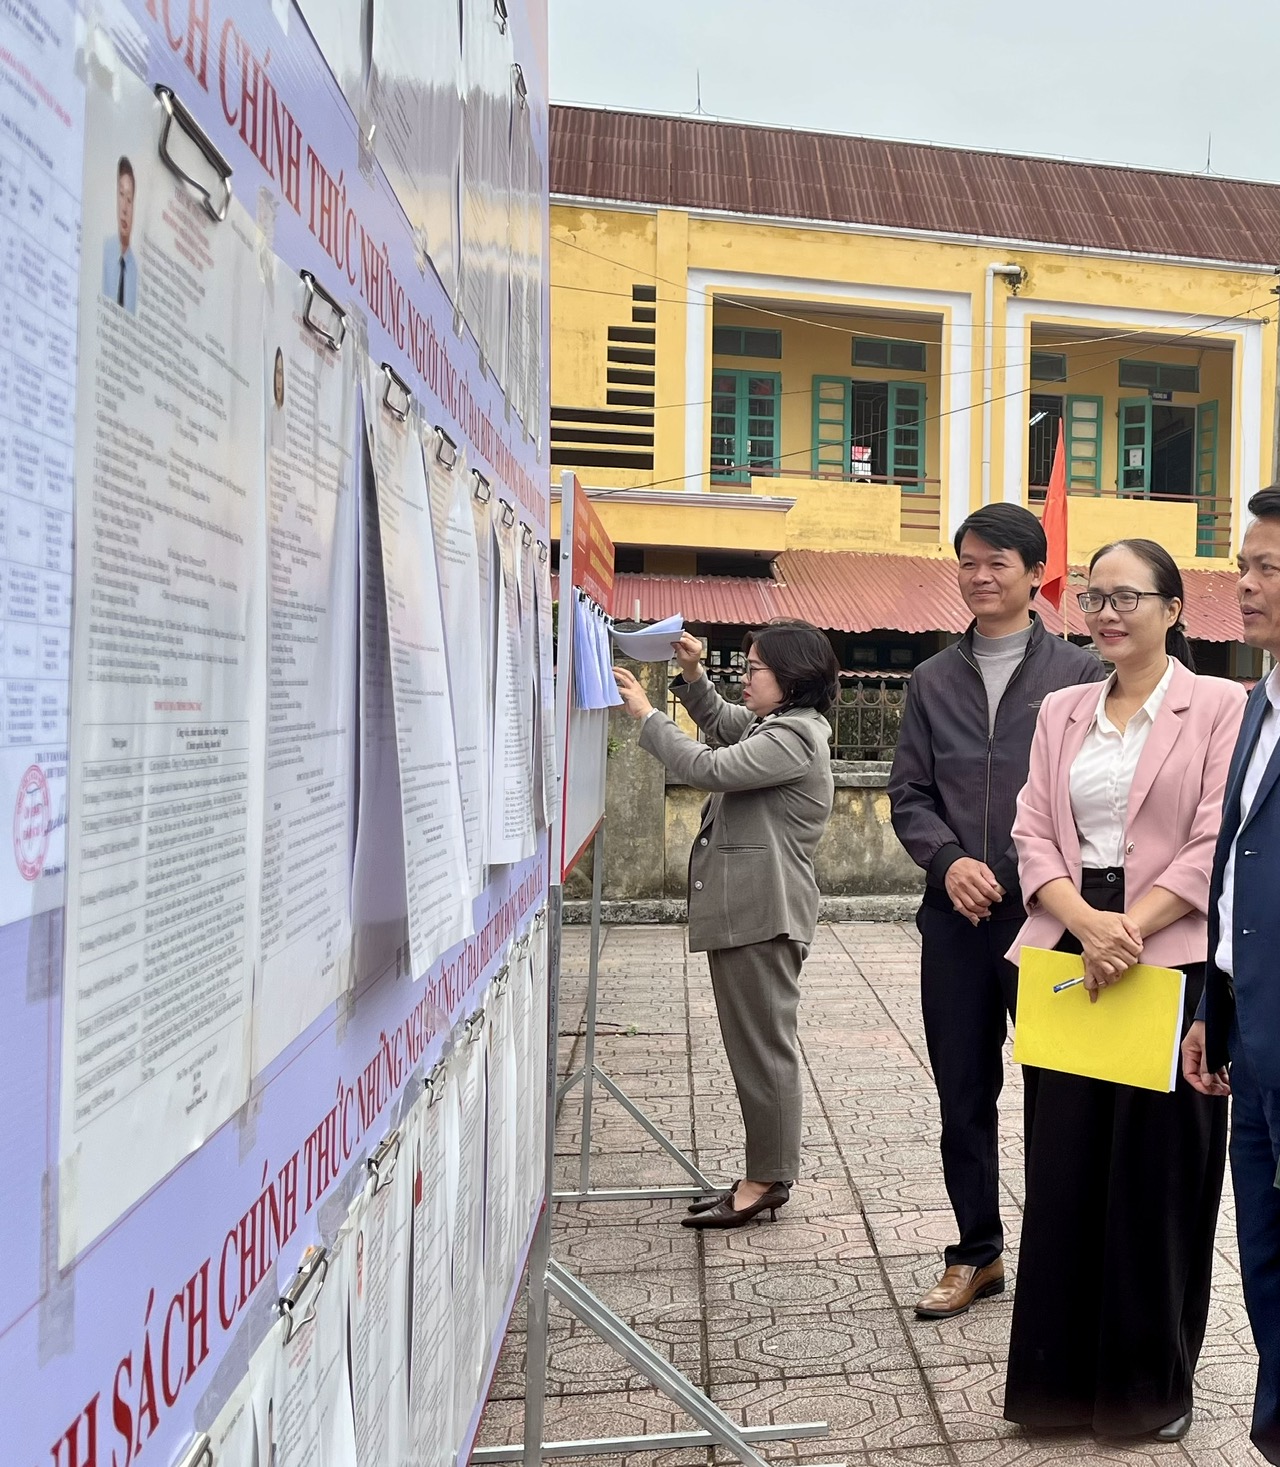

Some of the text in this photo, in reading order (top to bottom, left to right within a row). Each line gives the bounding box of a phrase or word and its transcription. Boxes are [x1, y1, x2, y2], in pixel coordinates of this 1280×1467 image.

[218, 16, 303, 217] CHÍNH
[307, 143, 357, 286] THỨC
[360, 225, 405, 351] NHỮNG
[407, 298, 439, 399] NGƯỜI
[439, 336, 457, 421] ỨNG
[458, 369, 470, 434] CỬ
[469, 393, 481, 460] ĐẠI
[112, 1257, 211, 1467] SÁCH
[218, 1150, 299, 1331] CHÍNH
[303, 1076, 354, 1215] THỨC
[356, 1028, 403, 1145] NHỮNG
[404, 974, 436, 1076] NGƯỜI
[438, 959, 456, 1015] ỨNG
[457, 938, 468, 1003] CỬ
[467, 934, 480, 995] ĐẠI
[480, 901, 494, 974] BIỂU
